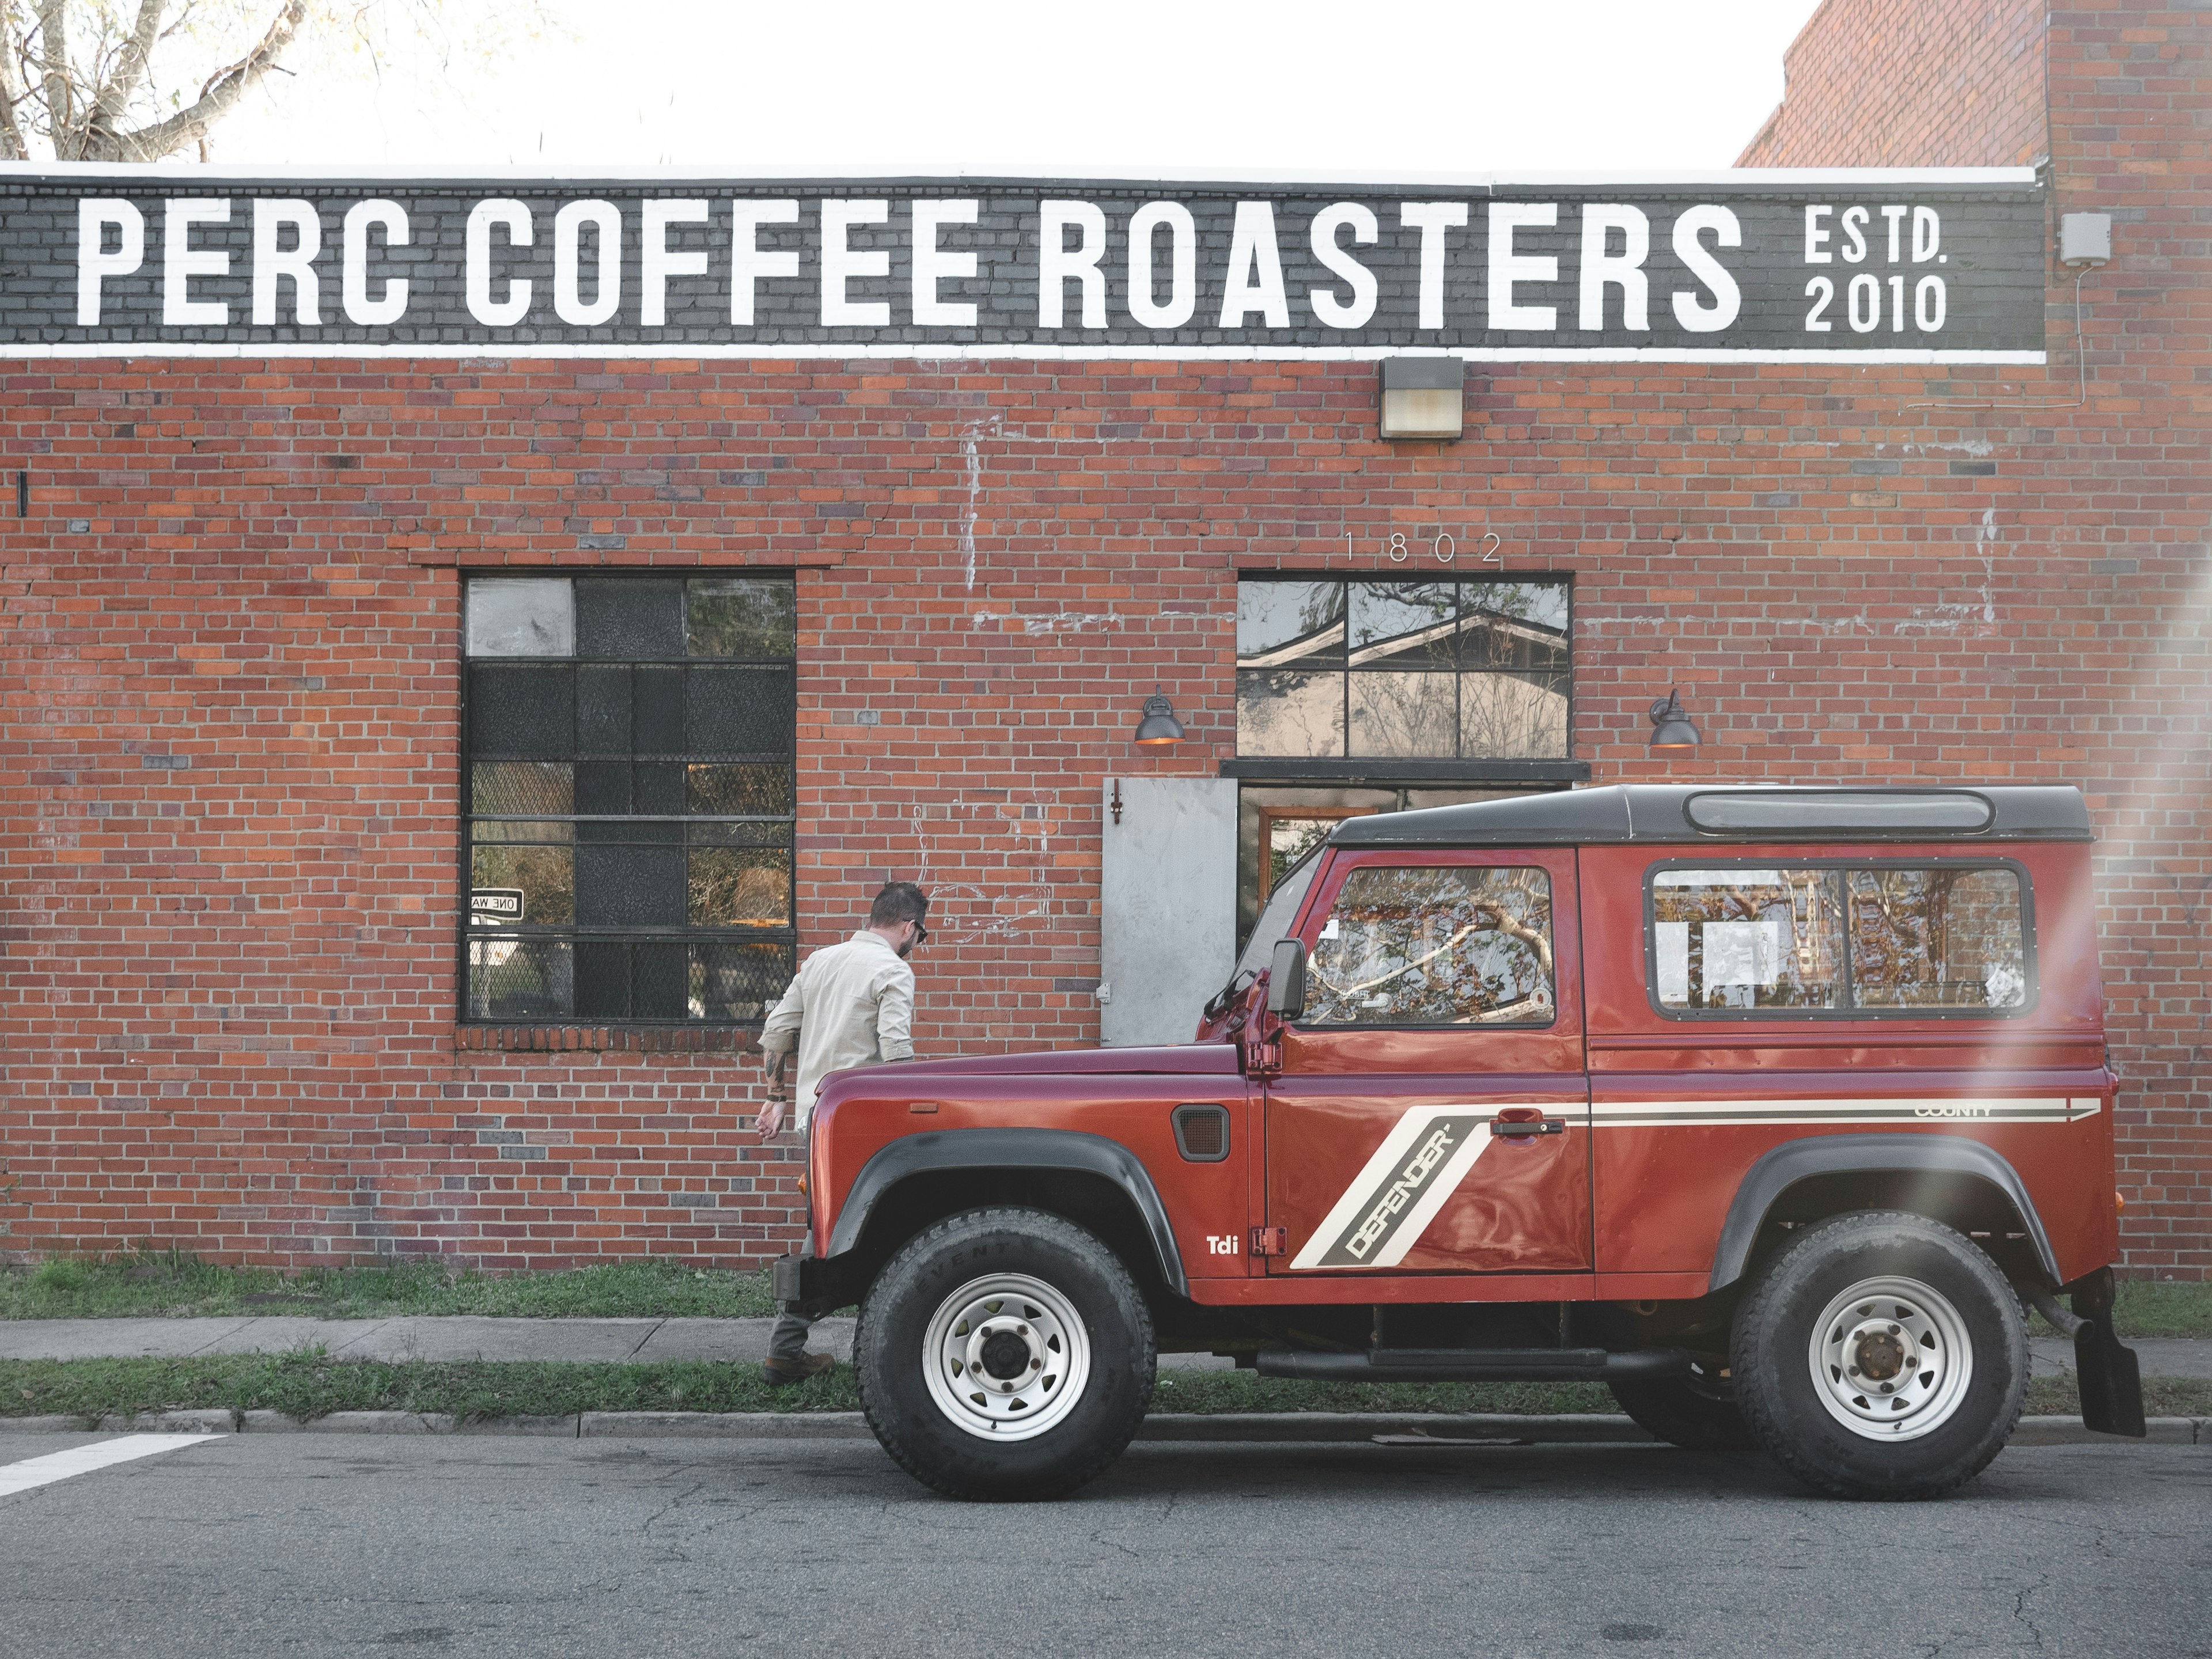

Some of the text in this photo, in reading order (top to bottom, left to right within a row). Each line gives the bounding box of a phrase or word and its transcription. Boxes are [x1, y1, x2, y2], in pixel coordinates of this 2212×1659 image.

[1804, 204, 1948, 264] ESTD.
[77, 198, 1743, 332] PERC COFFEE ROASTERS
[1804, 273, 1947, 334] 2010
[1344, 531, 1501, 563] 1802
[1914, 1103, 1993, 1117] COUNTY
[1344, 1123, 1455, 1260] DEFENDER
[1206, 1234, 1238, 1255] Tdi
